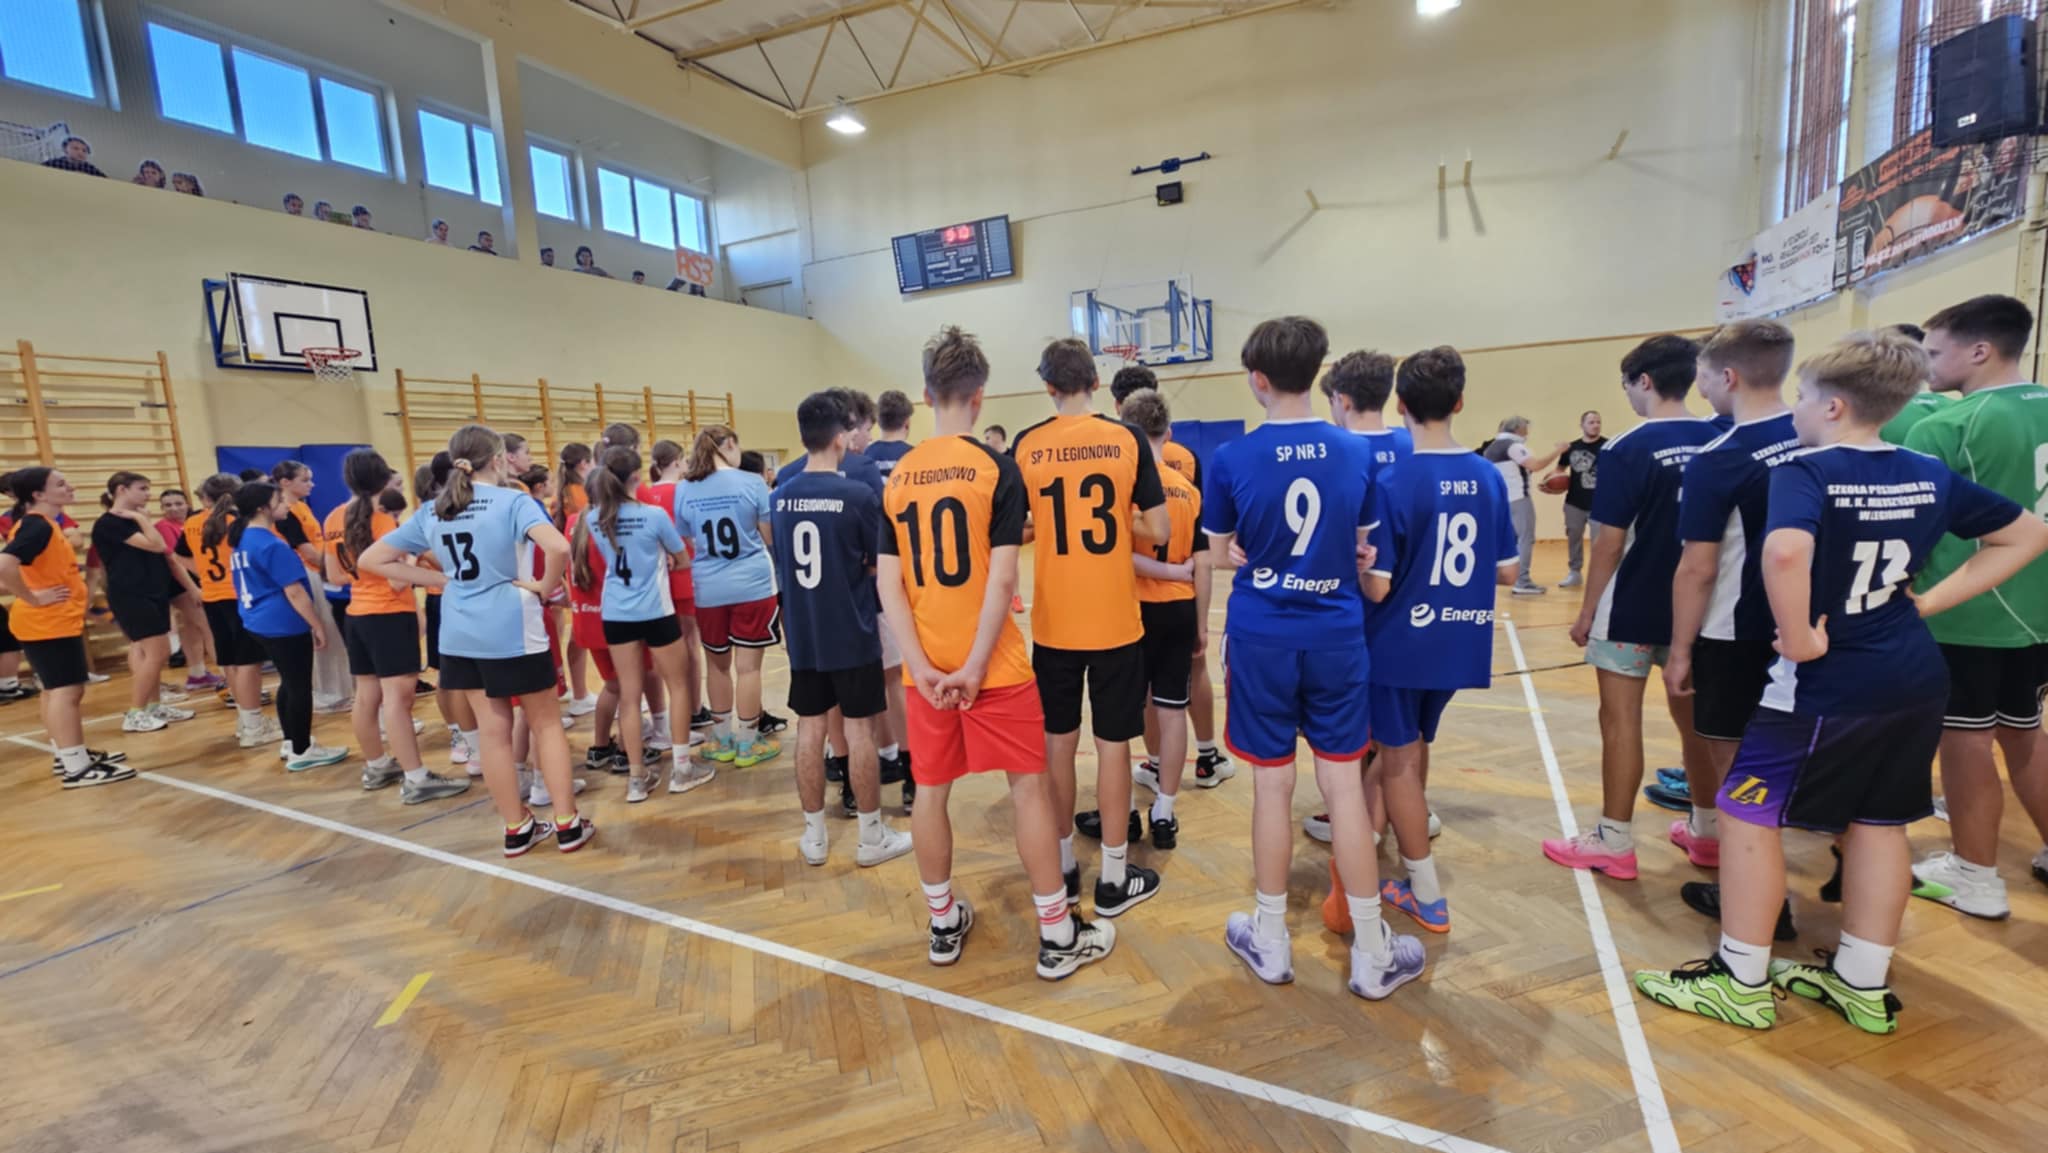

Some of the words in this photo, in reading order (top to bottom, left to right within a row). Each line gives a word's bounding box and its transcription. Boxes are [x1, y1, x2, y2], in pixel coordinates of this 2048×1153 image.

[1031, 449, 1043, 465] SP
[1046, 448, 1053, 463] 7
[1056, 444, 1121, 462] LEGIONOWO
[1276, 445, 1293, 462] SP
[1296, 443, 1317, 460] NR
[1318, 442, 1328, 459] 3
[1389, 451, 1396, 463] 3
[903, 472, 911, 486] 7
[913, 466, 976, 486] LEGIONOWO
[1440, 480, 1451, 495] SP
[1453, 480, 1469, 495] NR
[1470, 479, 1478, 495] 3
[776, 498, 785, 512] SP
[787, 498, 792, 512] 1
[793, 498, 844, 512] LEGIONOWO
[1039, 473, 1118, 556] 13
[1284, 477, 1321, 556] 9
[441, 531, 480, 581] 13
[701, 517, 740, 560] 19
[793, 520, 822, 589] 9
[896, 496, 971, 587] 10
[1429, 511, 1478, 587] 18
[201, 544, 226, 582] 3
[615, 546, 633, 586] 4
[1845, 538, 1911, 615] 13
[1282, 573, 1341, 594] Energa
[1441, 607, 1494, 625] Energa
[1728, 775, 1769, 805] LA
